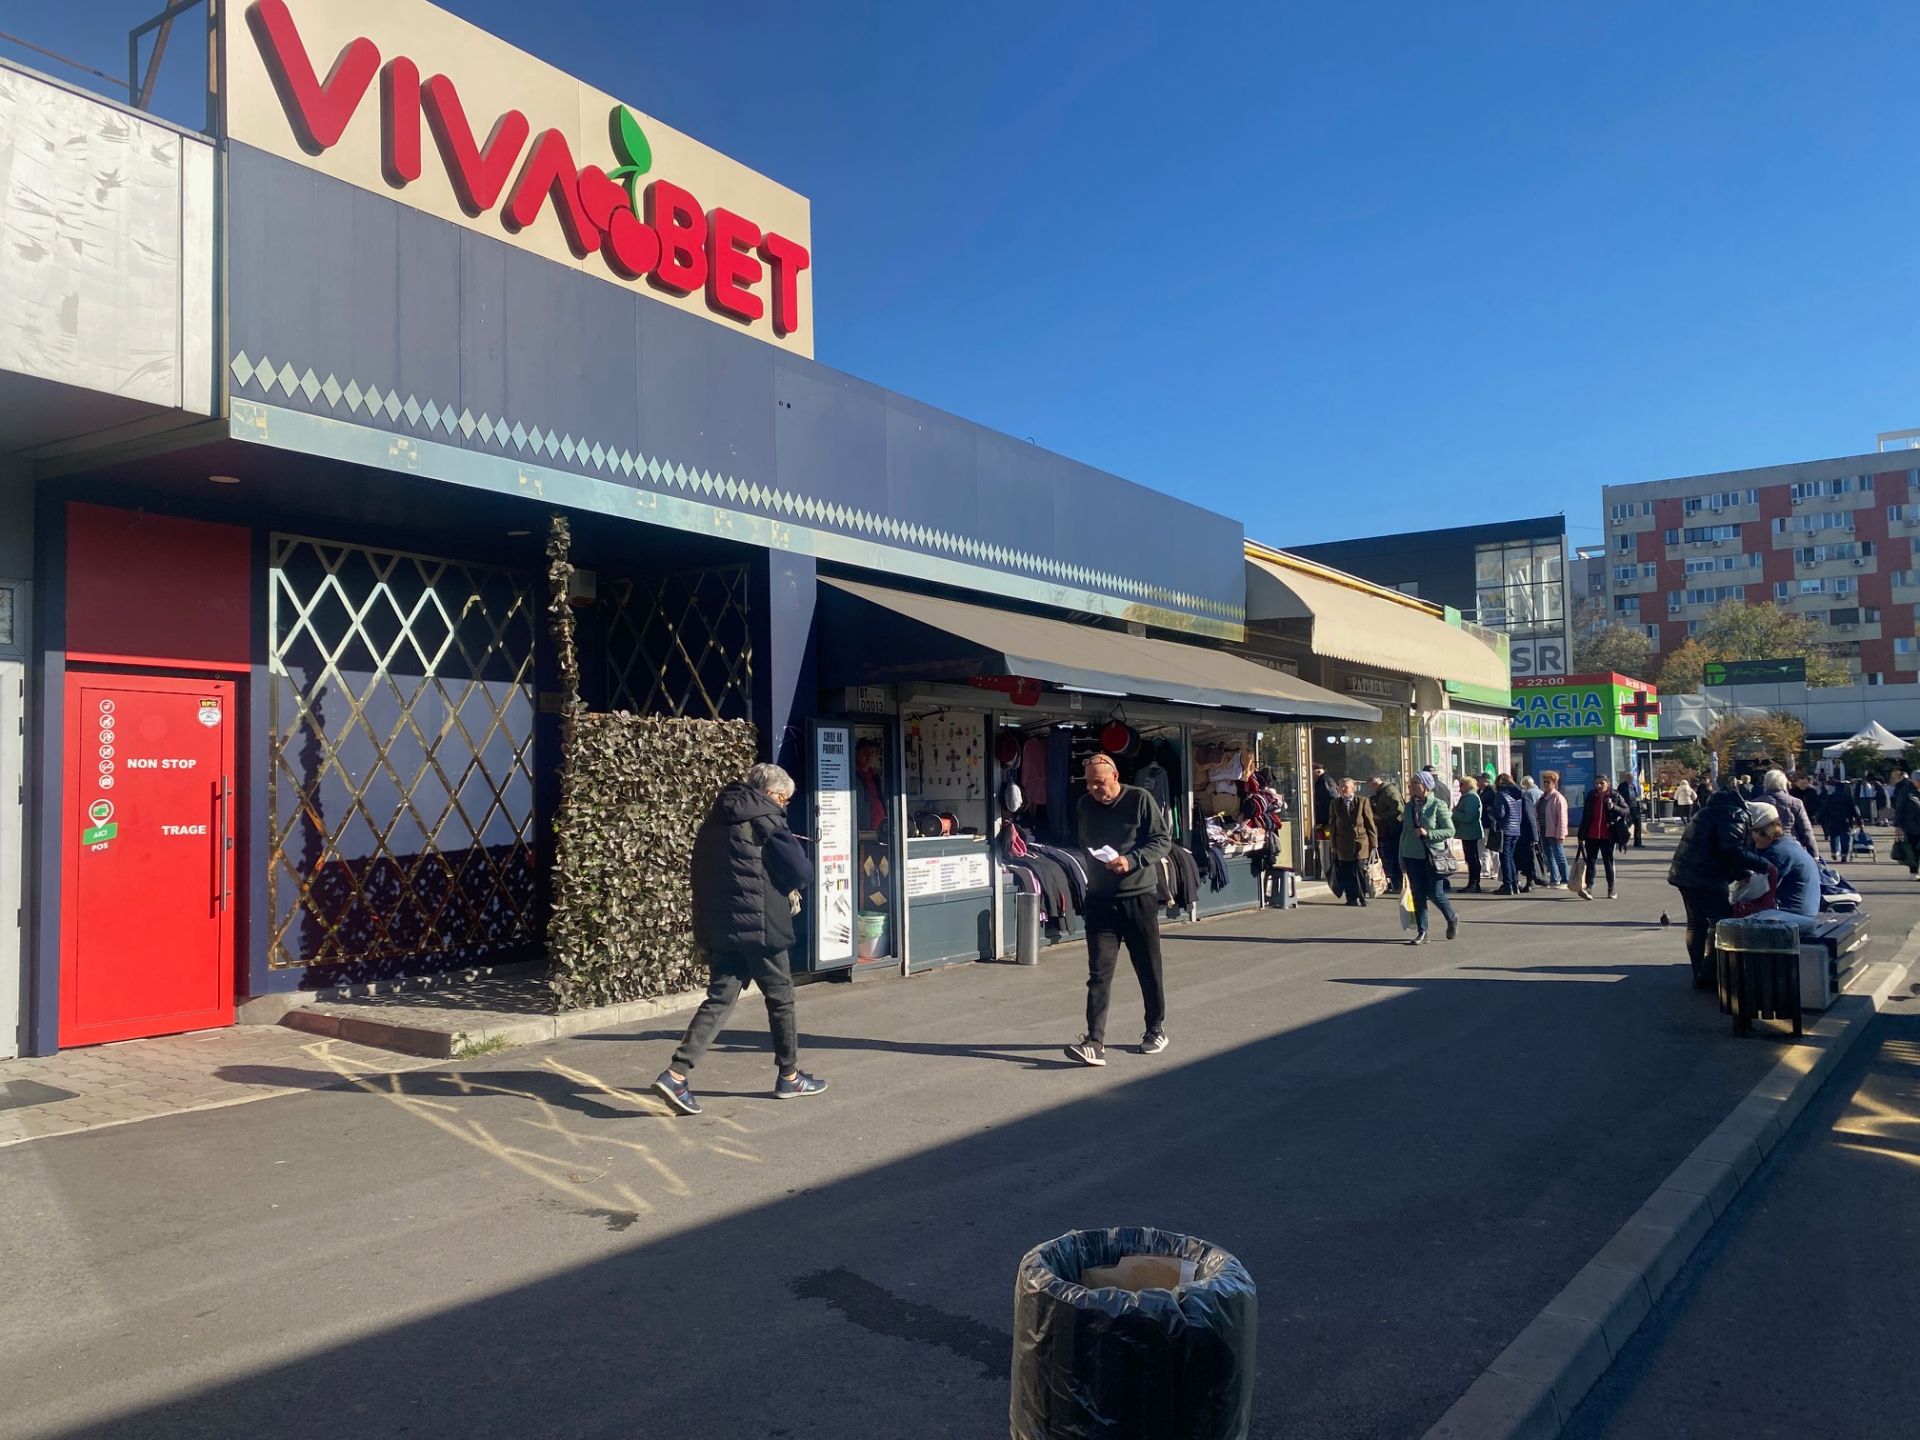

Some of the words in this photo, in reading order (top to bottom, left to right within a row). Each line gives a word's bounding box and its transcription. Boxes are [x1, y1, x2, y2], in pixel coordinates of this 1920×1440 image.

[1526, 677, 1565, 687] 22:00
[127, 758, 158, 769] NON
[161, 759, 197, 769] STOP
[161, 825, 207, 836] TRAGE
[91, 842, 109, 852] POS
